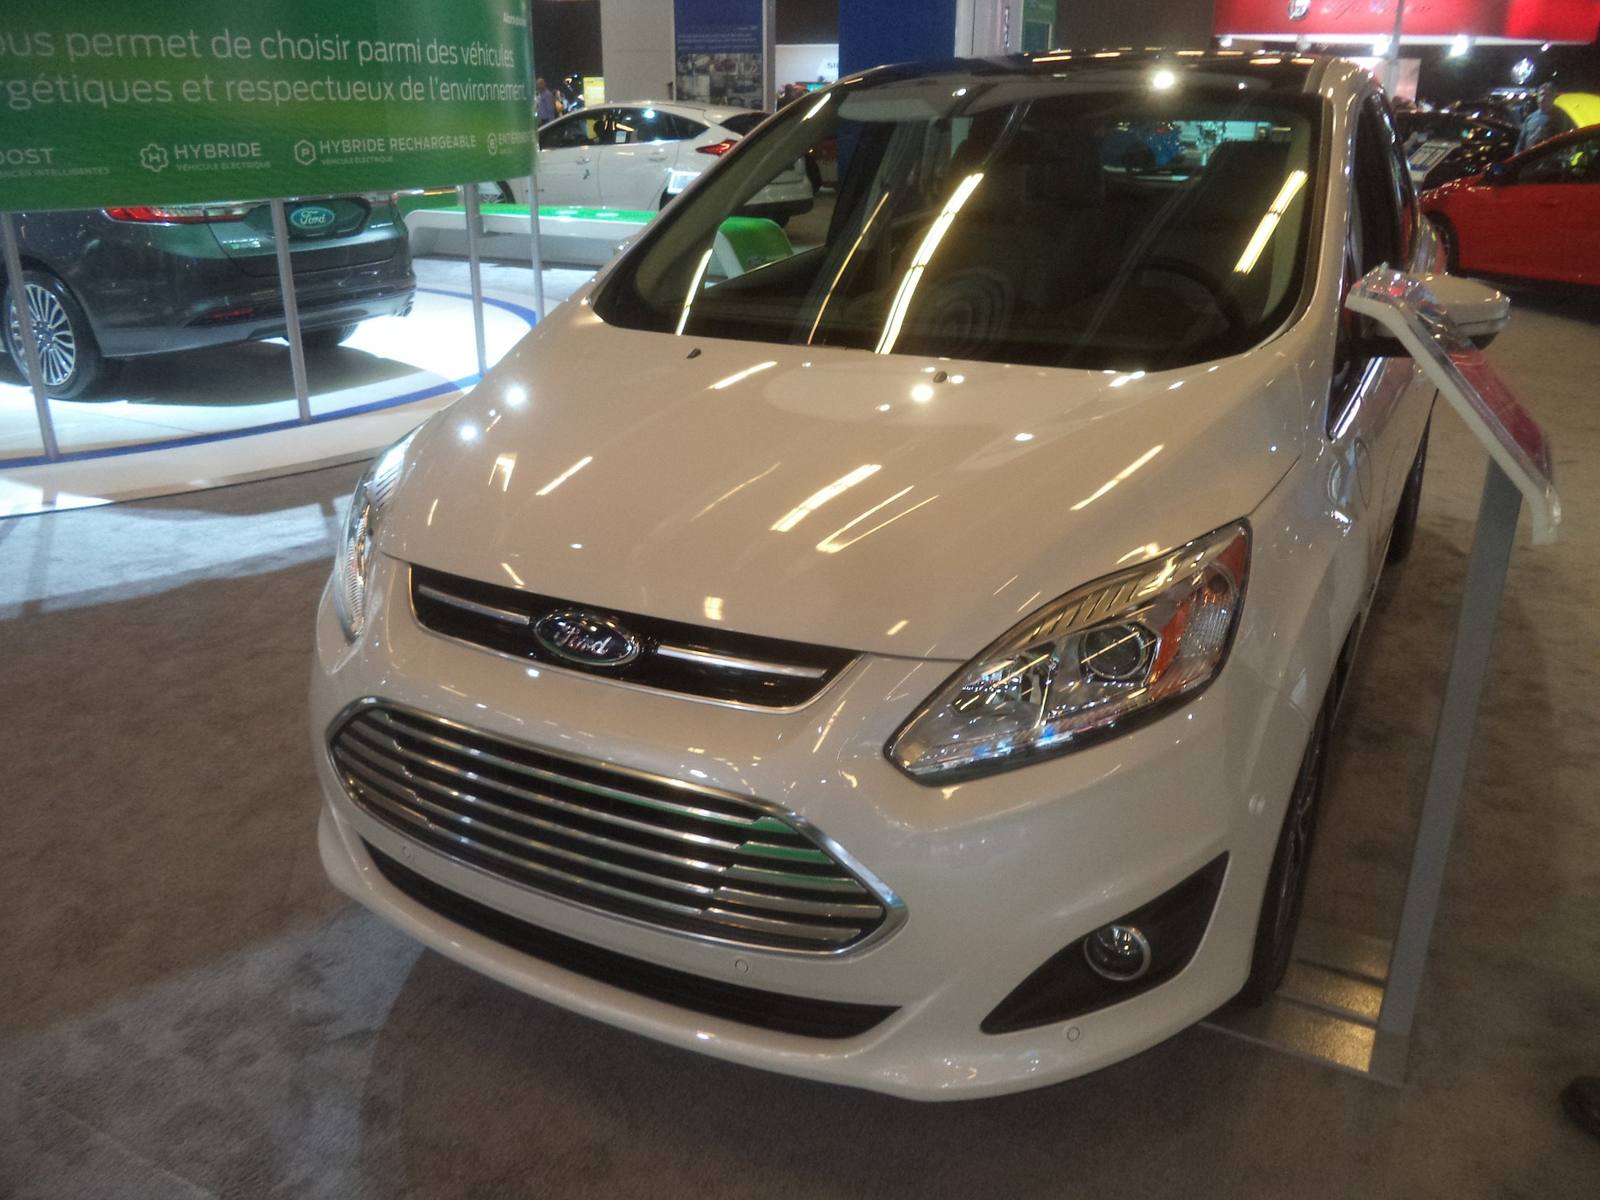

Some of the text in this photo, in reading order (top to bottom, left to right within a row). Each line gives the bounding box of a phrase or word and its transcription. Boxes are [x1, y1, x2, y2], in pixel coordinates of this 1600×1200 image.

[65, 28, 203, 63] permet
[211, 28, 253, 59] de
[260, 30, 350, 62] choisir
[357, 37, 422, 66] parmi
[426, 37, 459, 65] des
[460, 40, 515, 69] véhicules
[0, 72, 528, 111] gétiques et respectueux de l'environnement
[174, 142, 263, 160] HYBRIDE
[319, 138, 386, 155] HYBRIDE
[390, 134, 477, 152] RECHARGEABLE
[299, 208, 328, 226] Ford
[553, 622, 613, 655] Ford
